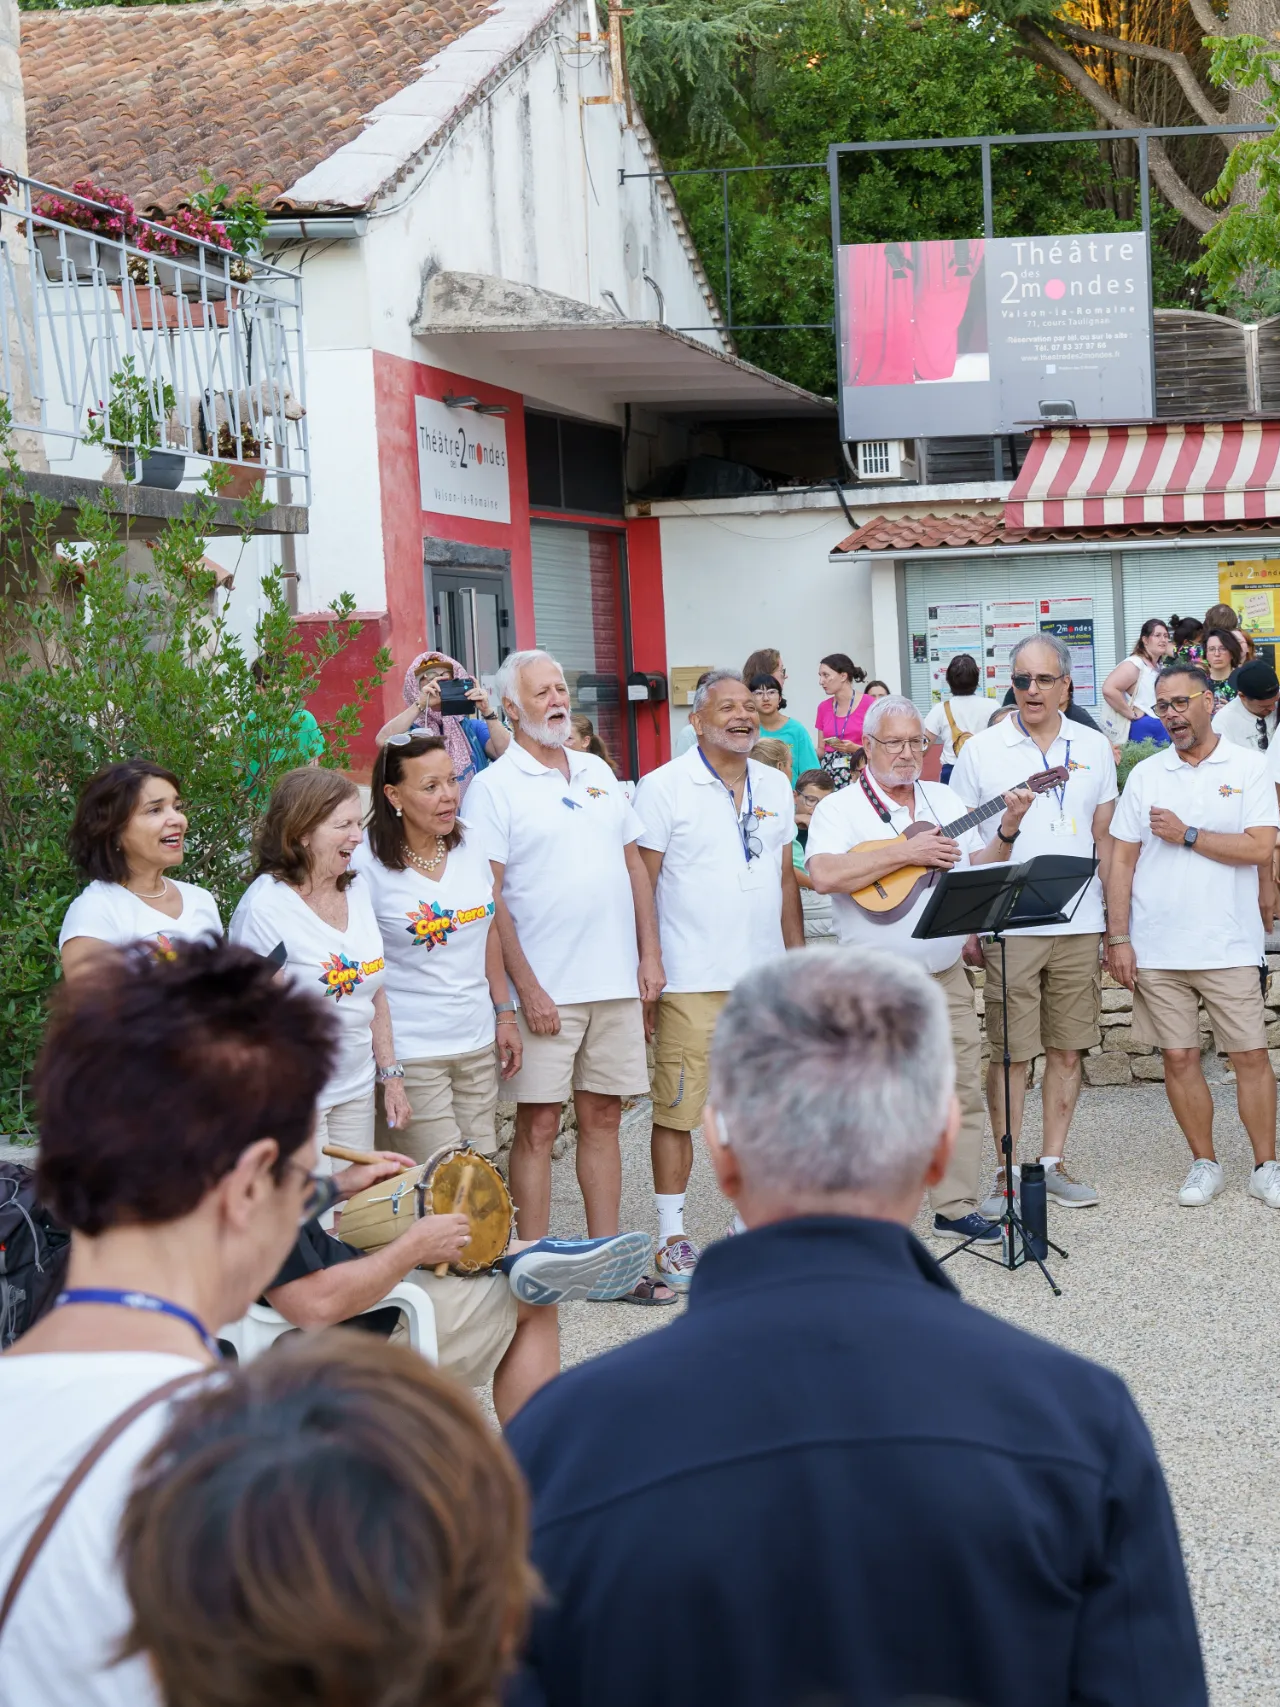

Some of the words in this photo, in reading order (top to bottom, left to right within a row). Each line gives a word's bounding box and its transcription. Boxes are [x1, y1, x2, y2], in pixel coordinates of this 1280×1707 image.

[1011, 240, 1133, 265] Théâtre
[1020, 269, 1040, 278] des
[1001, 306, 1135, 318] Vaison-la-Romaine
[1068, 318, 1111, 326] Taulignan
[419, 426, 460, 457] Théâtre
[433, 487, 498, 510] Vaison-la-Romaine
[416, 916, 451, 935] Coro
[327, 967, 357, 986] Coro
